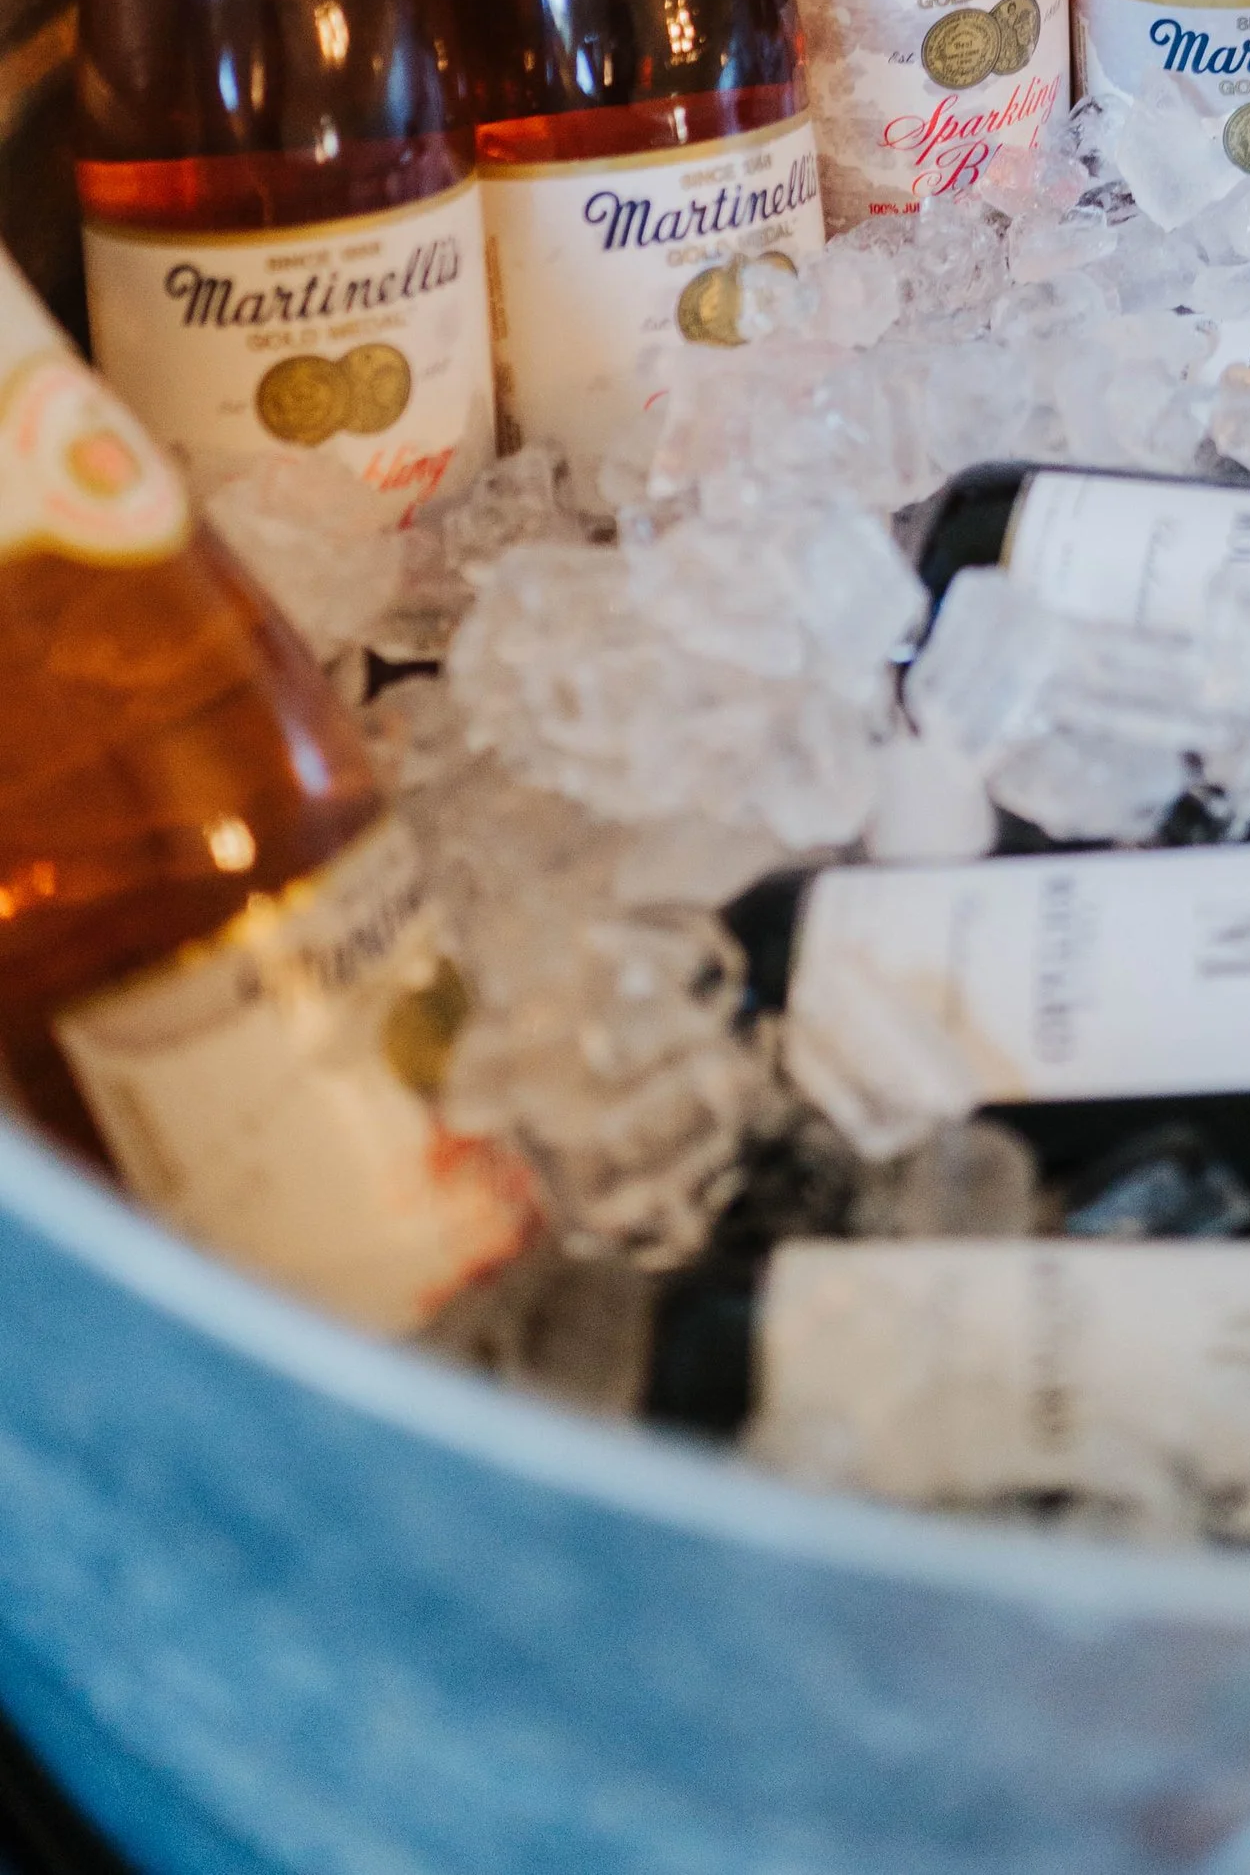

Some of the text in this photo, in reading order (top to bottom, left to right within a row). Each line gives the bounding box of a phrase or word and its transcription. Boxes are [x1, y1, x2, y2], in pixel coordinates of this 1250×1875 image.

[877, 75, 1061, 167] Sparkling
[868, 202, 921, 215] 100% JUI
